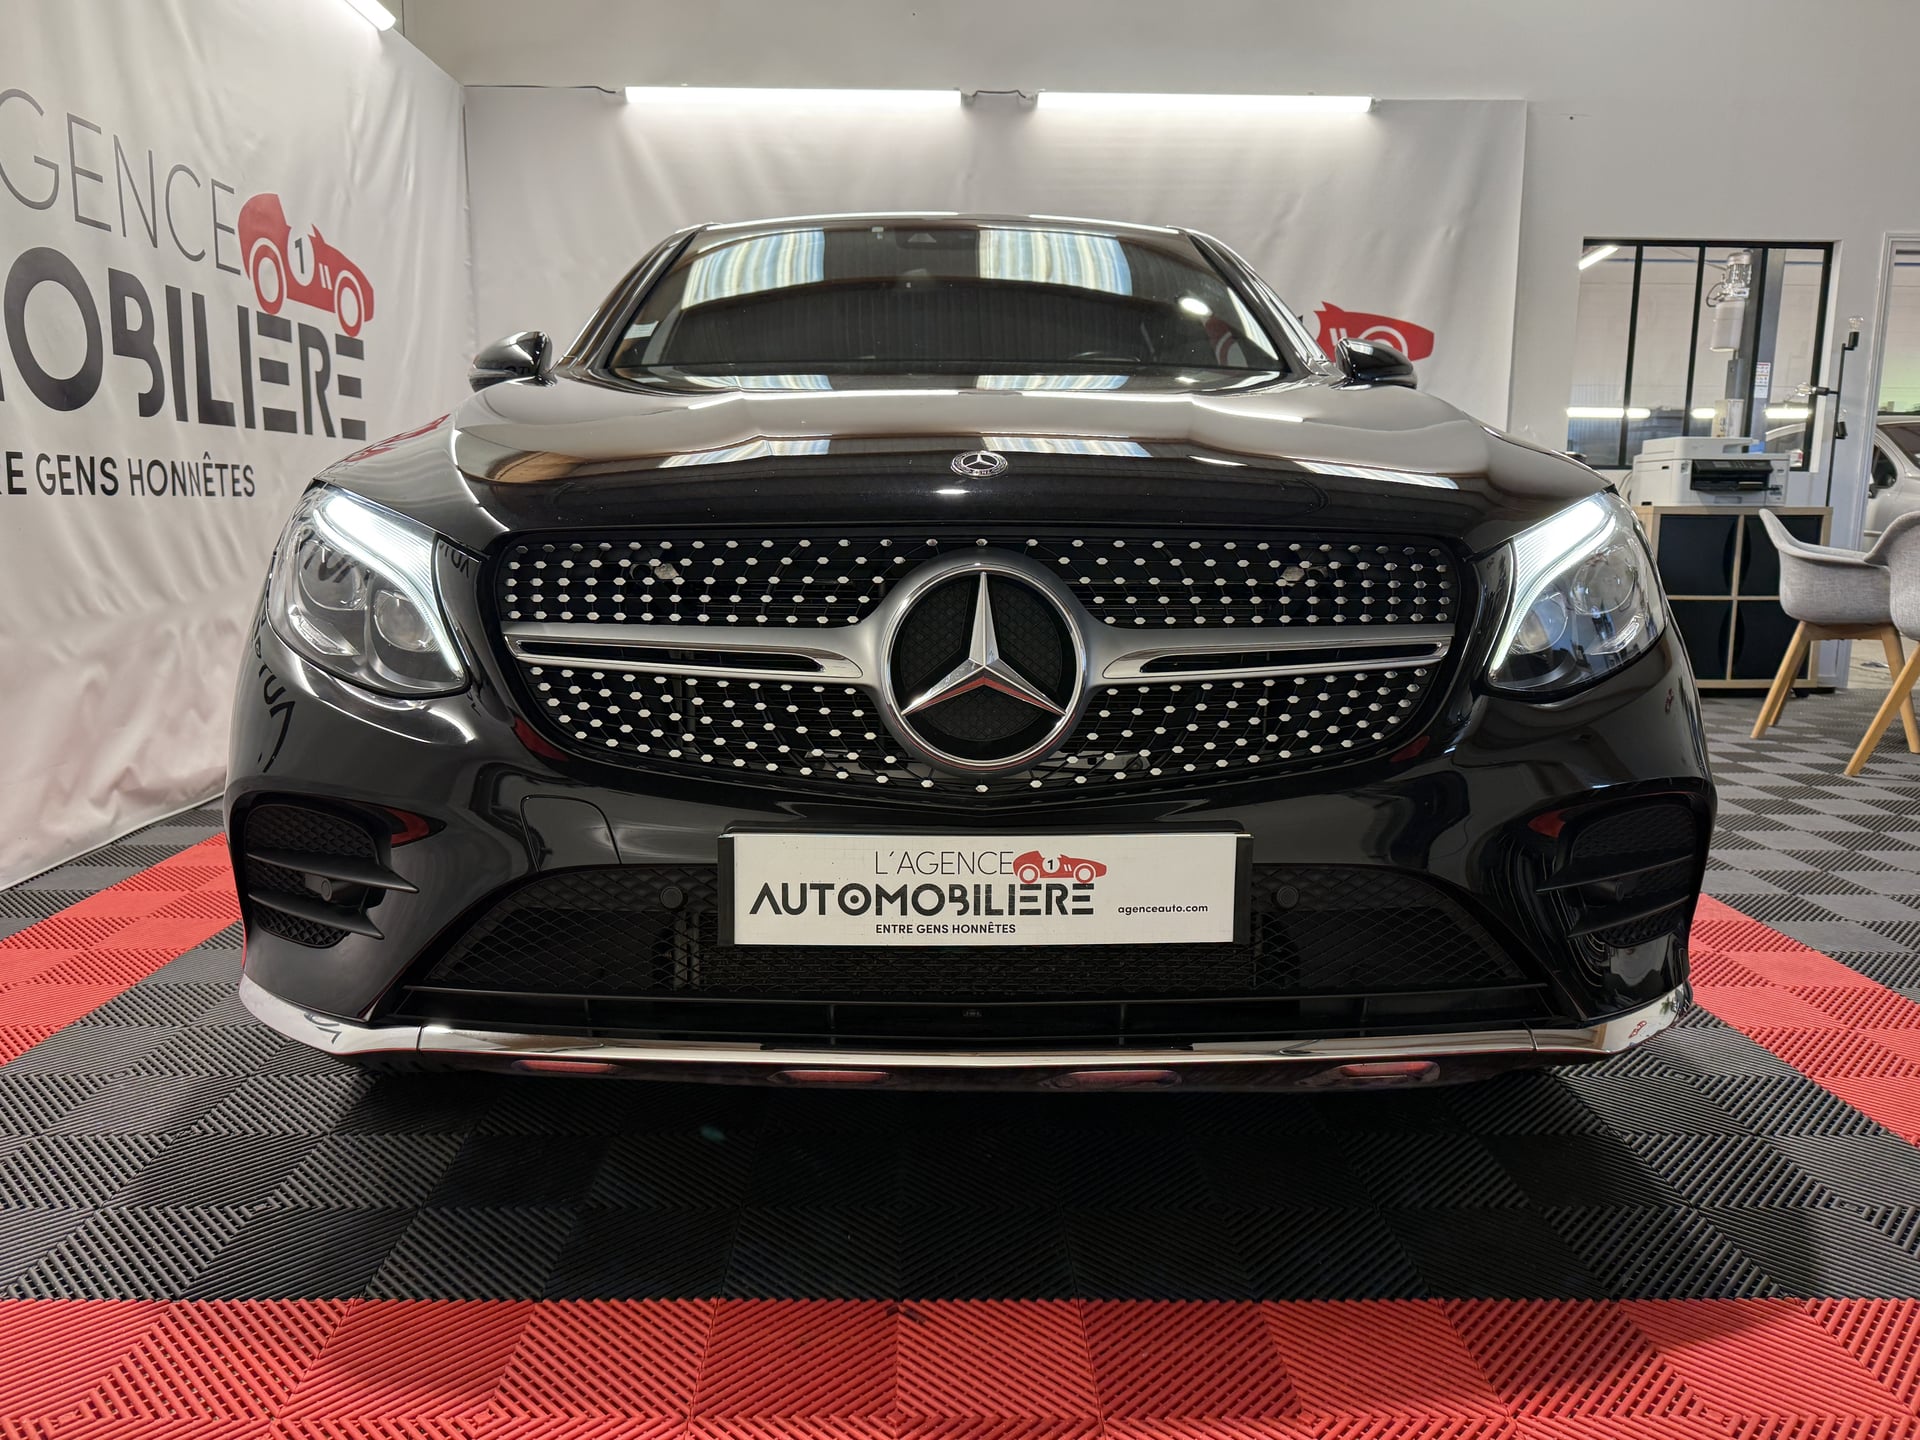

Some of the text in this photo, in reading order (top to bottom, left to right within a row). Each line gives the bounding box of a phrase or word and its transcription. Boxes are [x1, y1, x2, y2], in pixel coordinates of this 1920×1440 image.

[0, 246, 367, 441] OBILIERE
[36, 453, 119, 496] GENS
[128, 452, 256, 498] HONNÊTES
[875, 851, 1014, 875] L'AGENCE
[1047, 859, 1054, 870] 1
[749, 882, 1095, 916] AUTOMOBILIERE
[1117, 904, 1209, 916] agenceauto.com
[875, 921, 1016, 934] ENTRE GENS HONNÊTES
